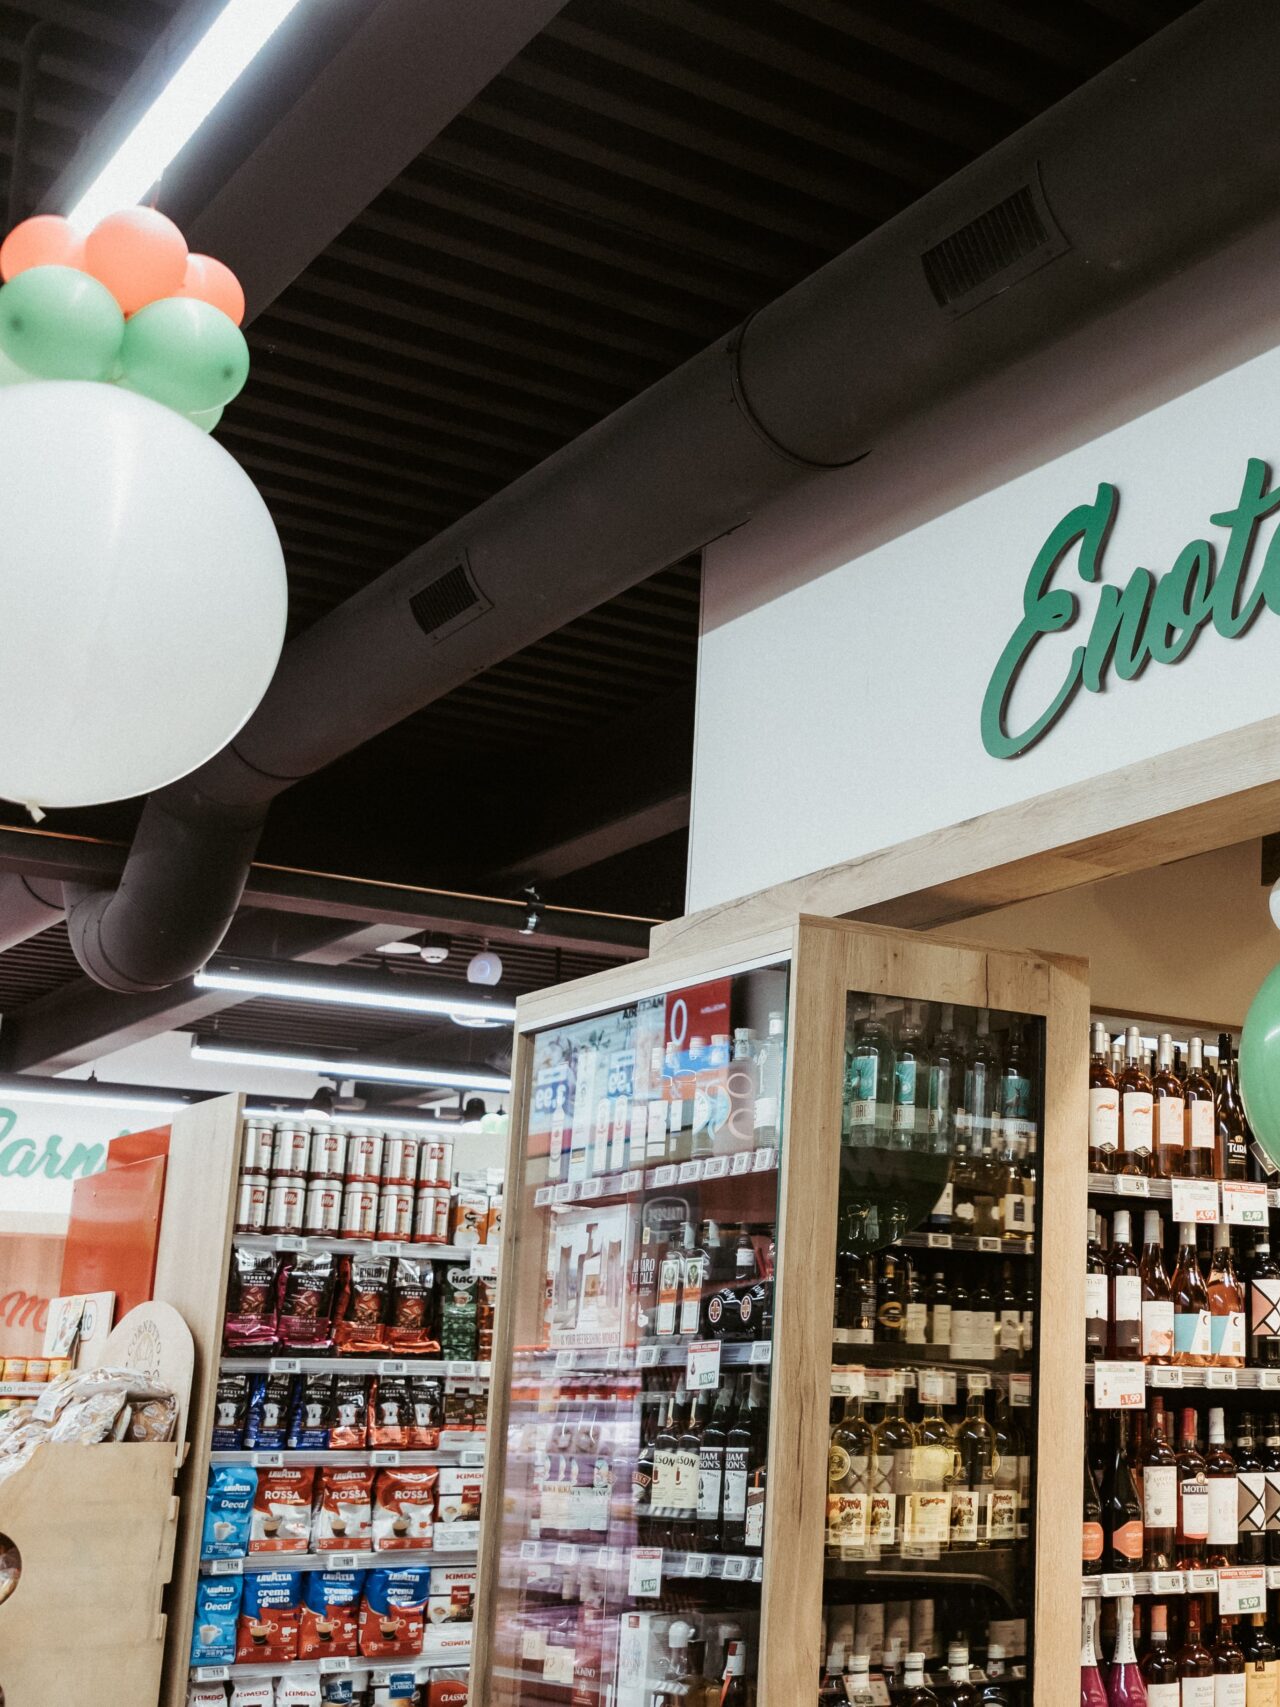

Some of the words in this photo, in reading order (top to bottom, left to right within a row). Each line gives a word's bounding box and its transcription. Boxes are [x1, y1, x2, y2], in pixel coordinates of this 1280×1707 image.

[451, 1275, 474, 1284] HAG
[268, 1469, 302, 1479] LAVAZZA
[333, 1471, 367, 1481] LAVAZZA
[221, 1500, 249, 1509] Decaf
[256, 1572, 292, 1582] LAVAZZA
[323, 1572, 355, 1581] LAVAZZA
[258, 1588, 291, 1596] crema
[324, 1587, 353, 1595] crema
[204, 1601, 232, 1610] Decaf
